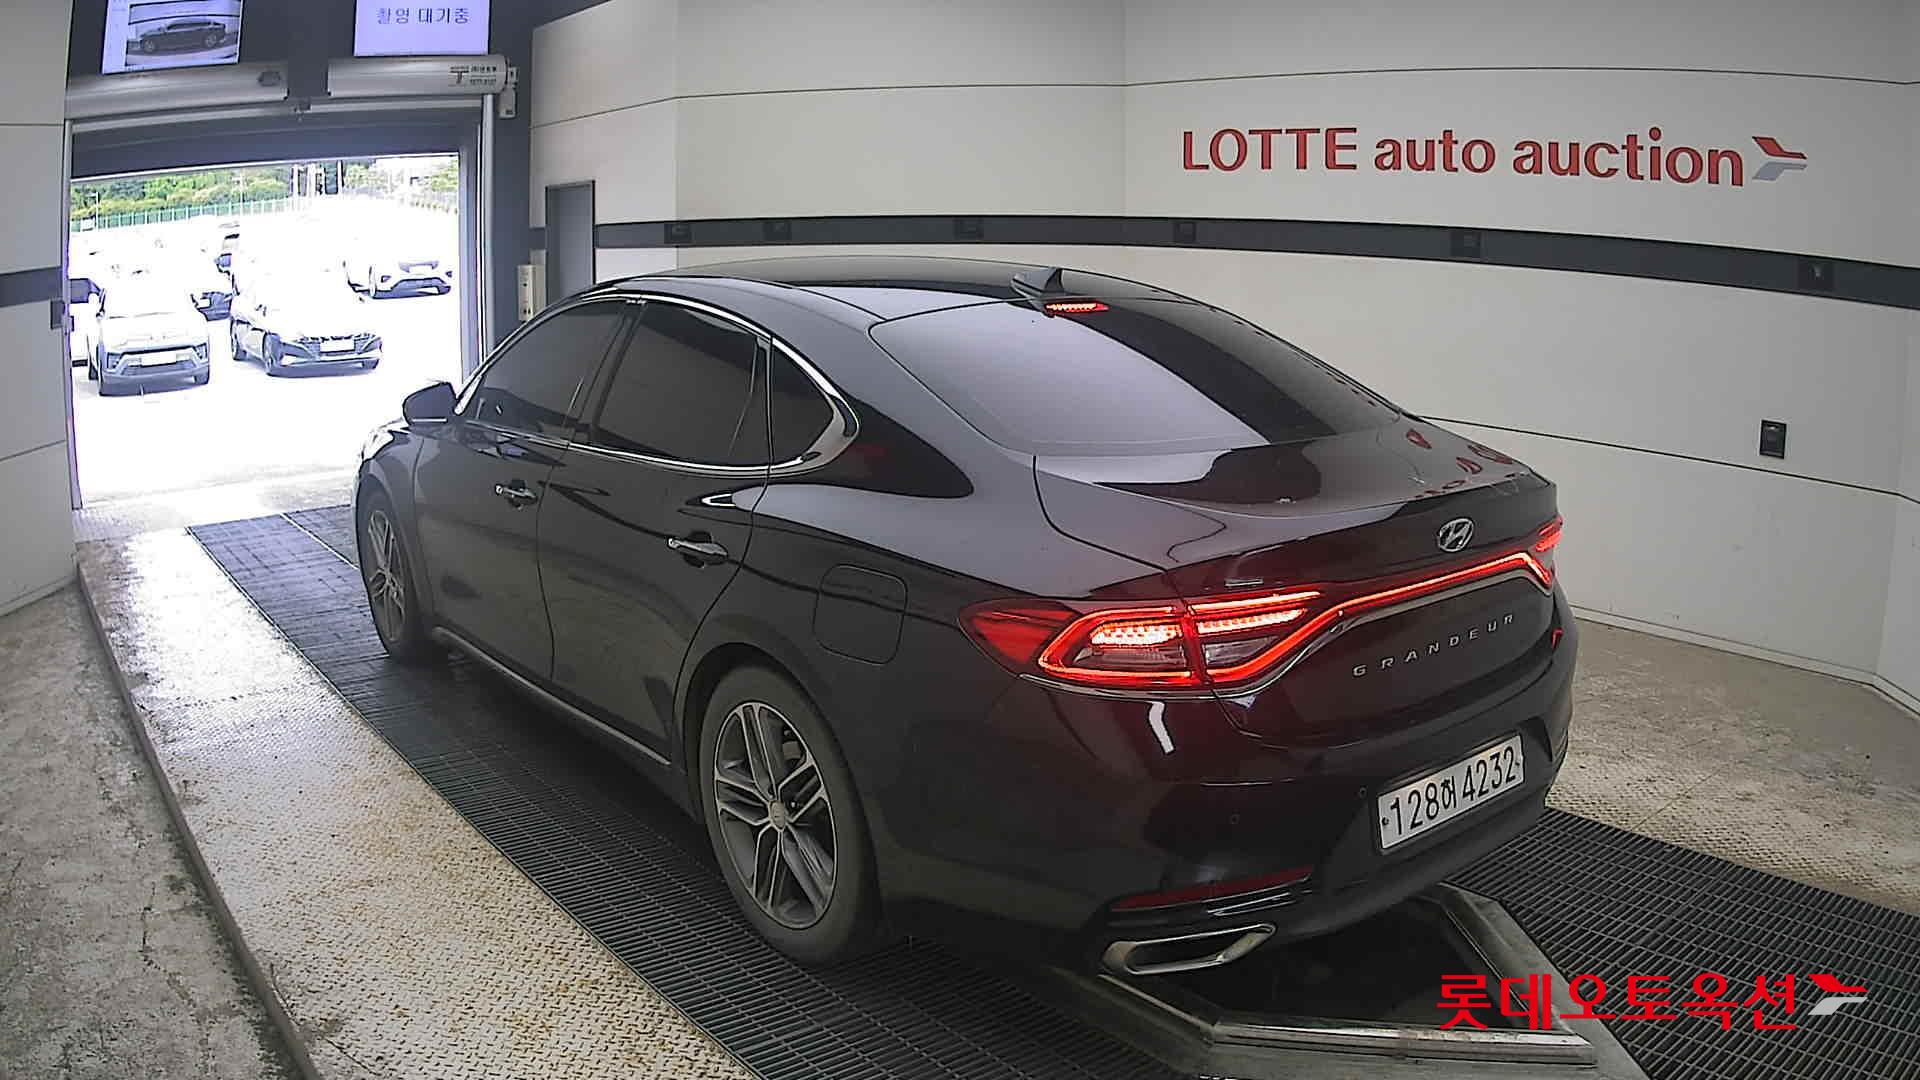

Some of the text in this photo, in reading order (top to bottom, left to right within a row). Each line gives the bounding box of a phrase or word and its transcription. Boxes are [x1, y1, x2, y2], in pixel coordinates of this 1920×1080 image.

[376, 8, 469, 24] 촬영 대기중
[1183, 126, 1743, 186] LOTTE auto auction
[1353, 614, 1513, 676] GRANDEUR
